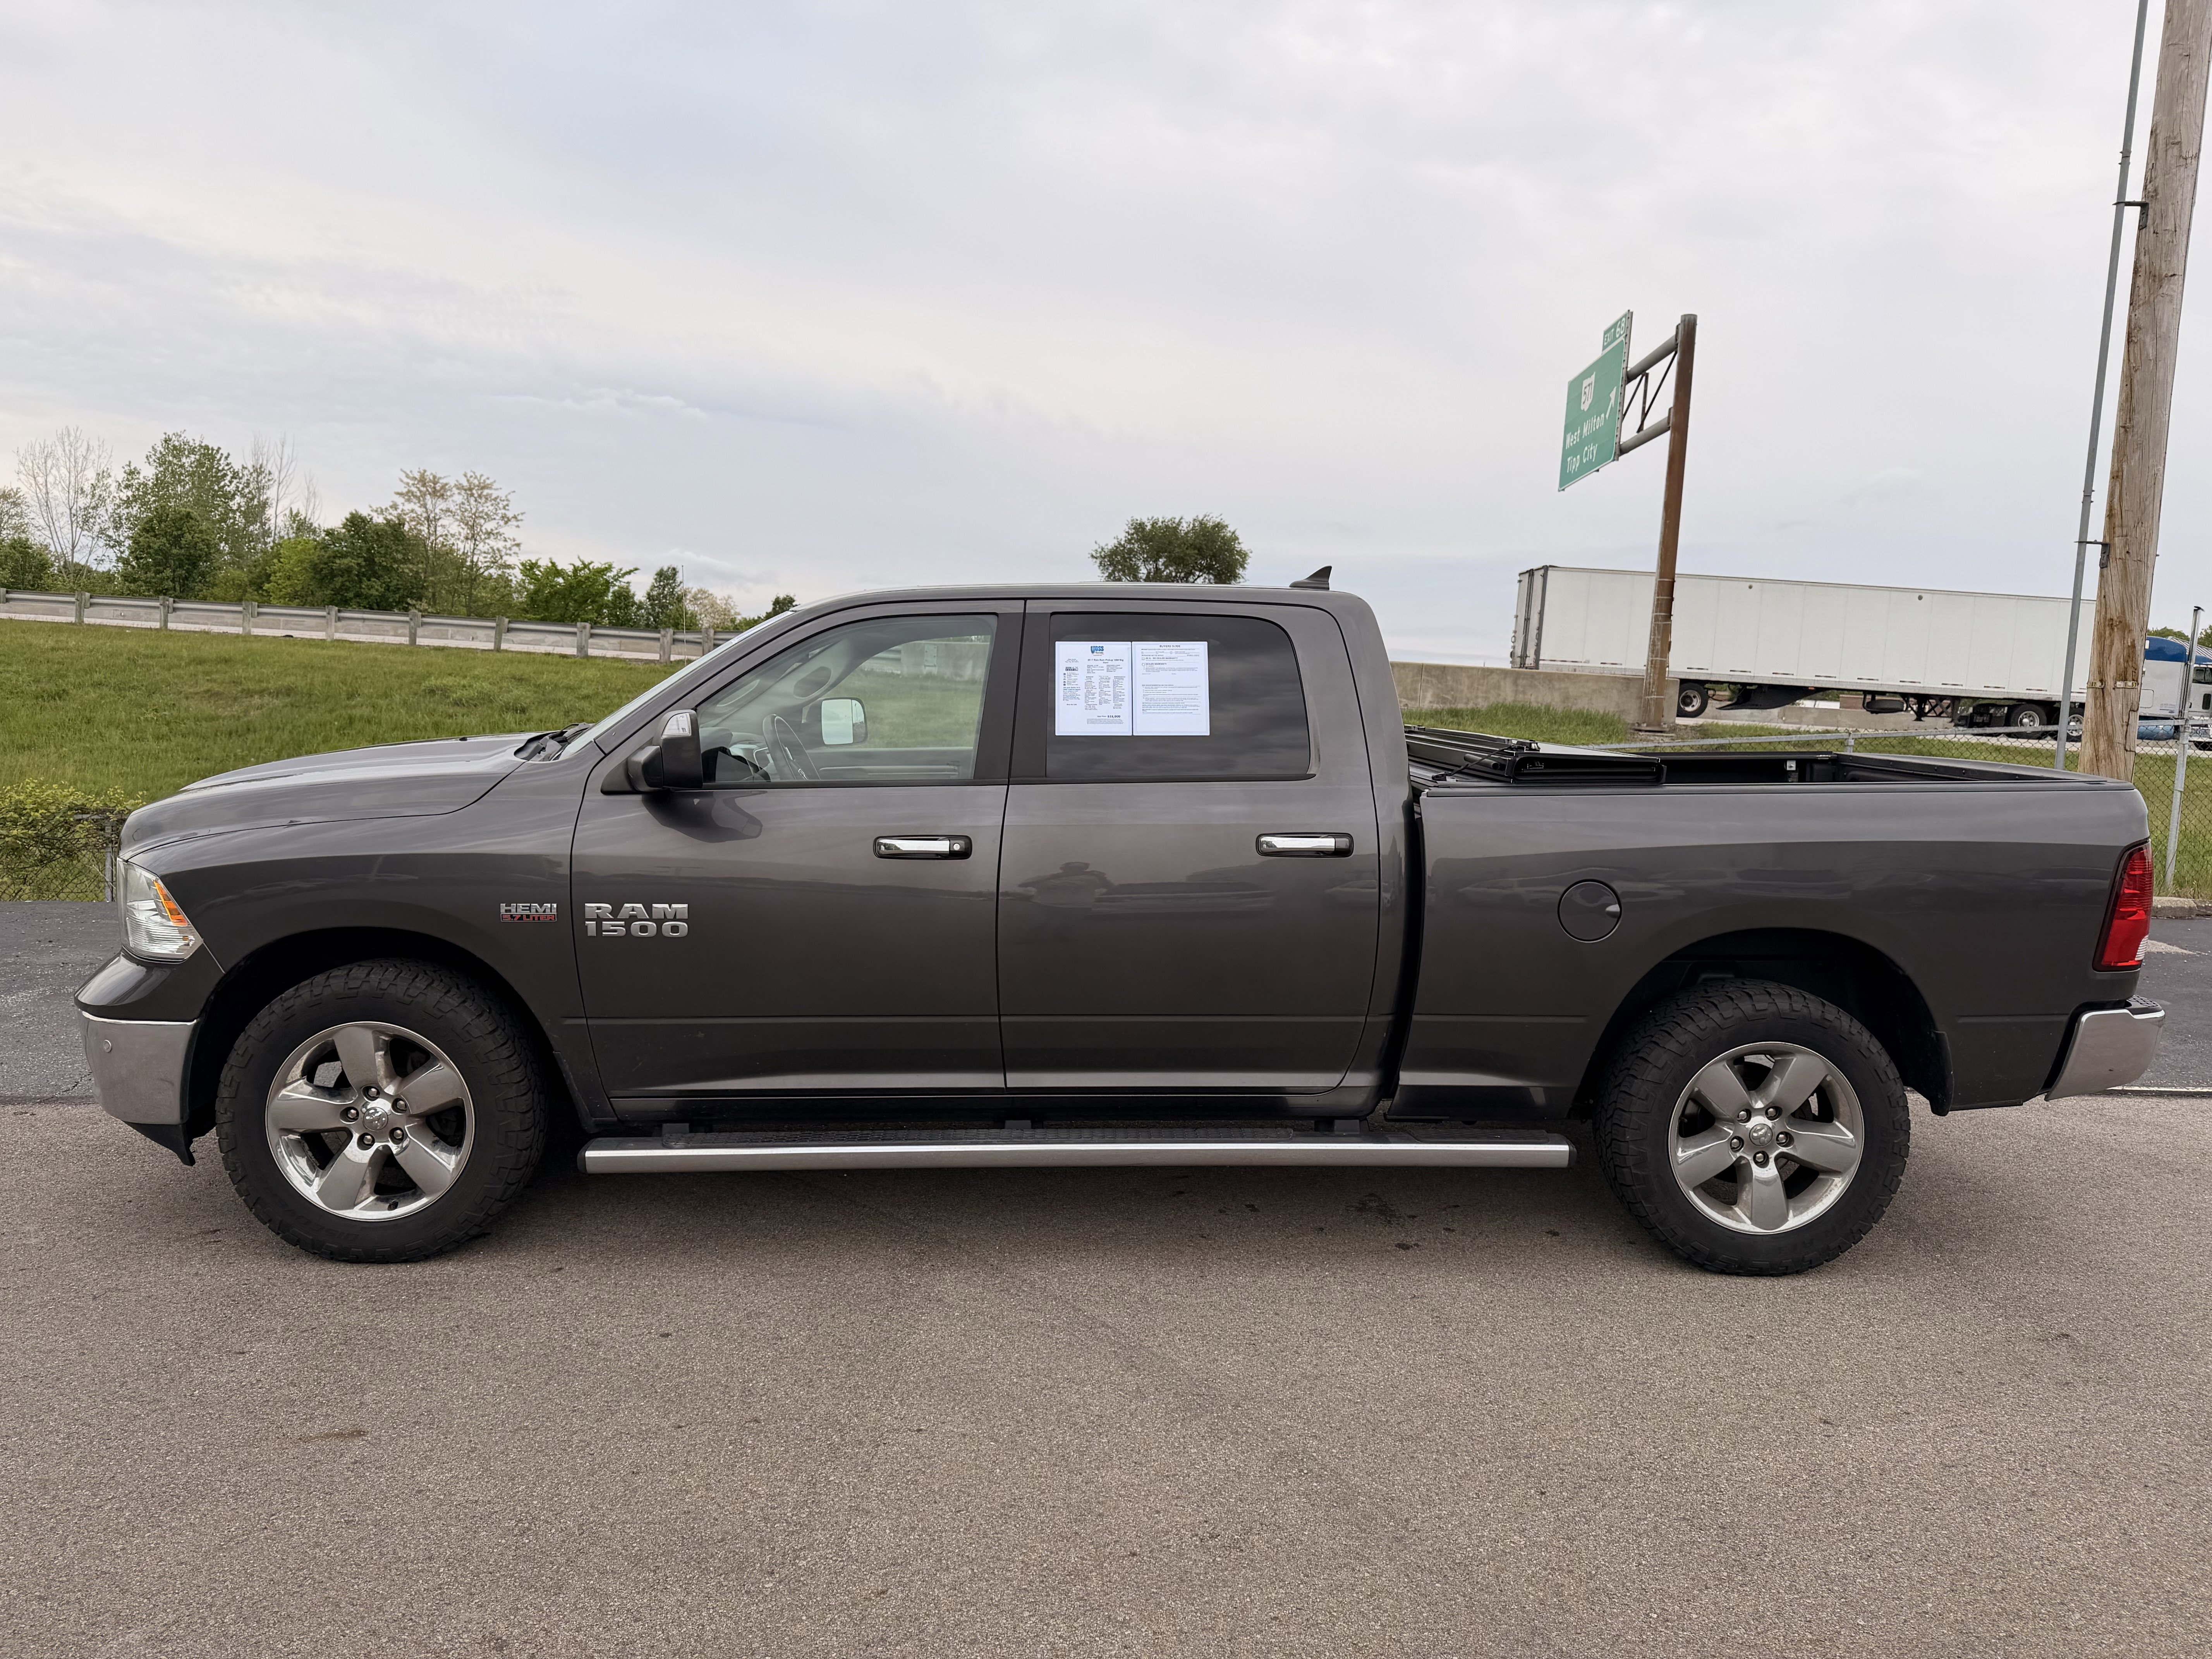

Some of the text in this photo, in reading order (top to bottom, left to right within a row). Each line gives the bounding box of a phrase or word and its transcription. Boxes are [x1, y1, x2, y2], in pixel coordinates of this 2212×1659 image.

[1604, 317, 1625, 345] EXIT 68
[1583, 381, 1593, 405] 571
[1566, 413, 1604, 450] West Milton
[1567, 443, 1598, 474] Tipp City
[500, 903, 557, 913] HEMI
[585, 903, 688, 919] RAM
[585, 921, 688, 938] 1500
